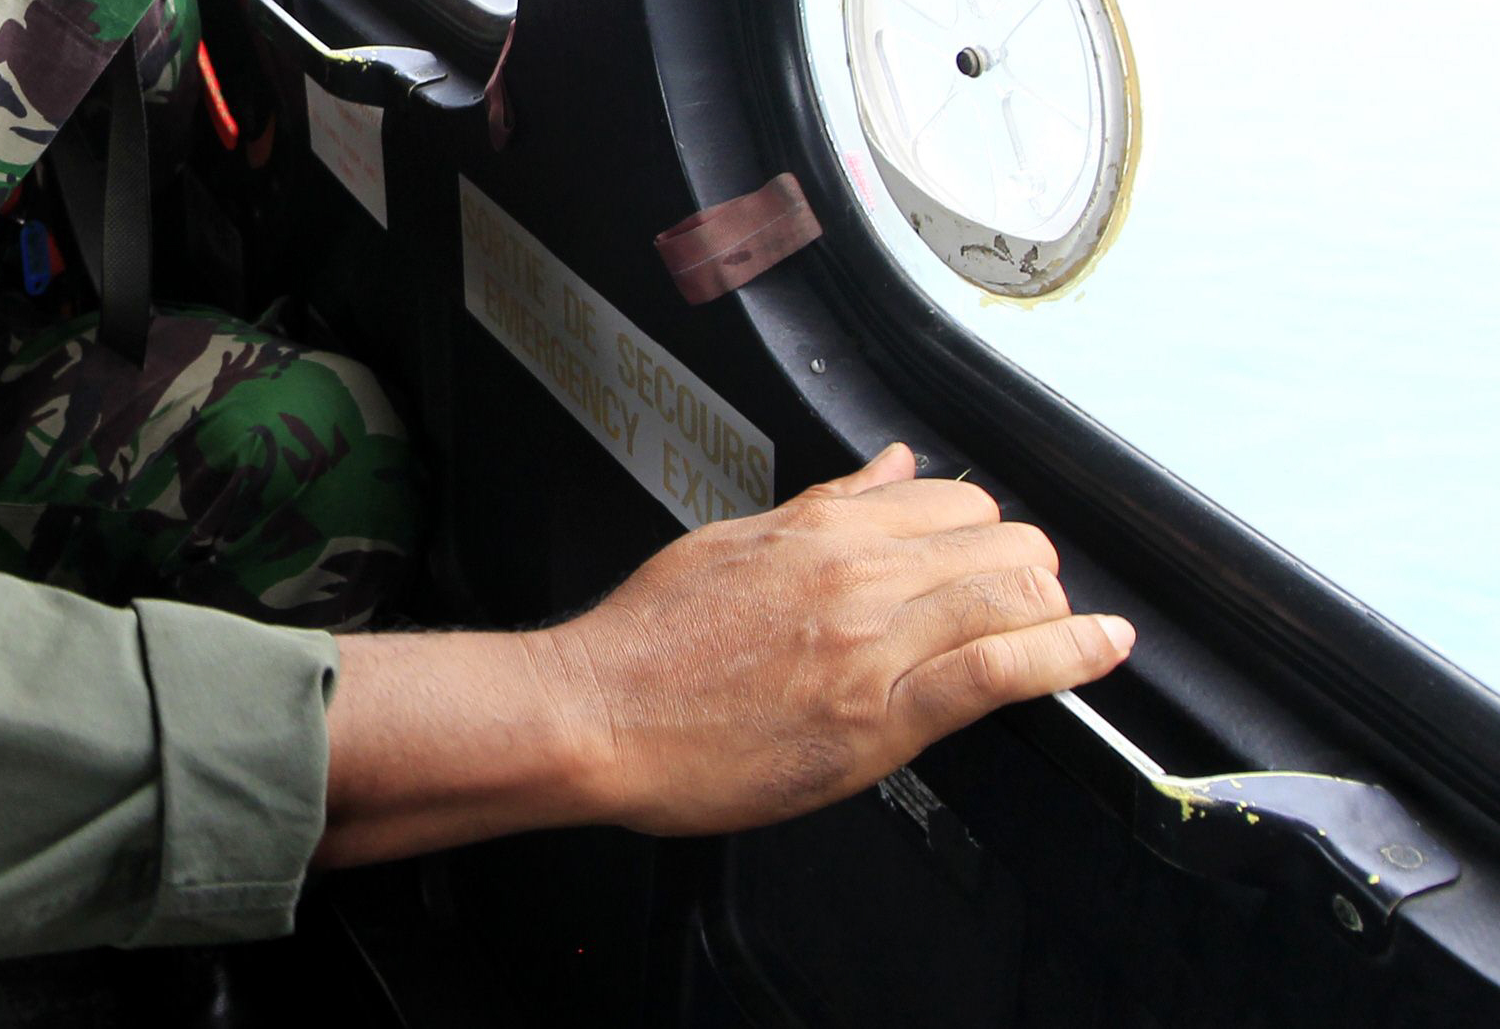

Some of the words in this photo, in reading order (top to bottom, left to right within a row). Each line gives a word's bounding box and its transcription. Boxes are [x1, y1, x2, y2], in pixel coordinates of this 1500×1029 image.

[484, 271, 640, 458] EMERGENCY
[563, 282, 597, 357] DE
[617, 331, 769, 508] SECOURS
